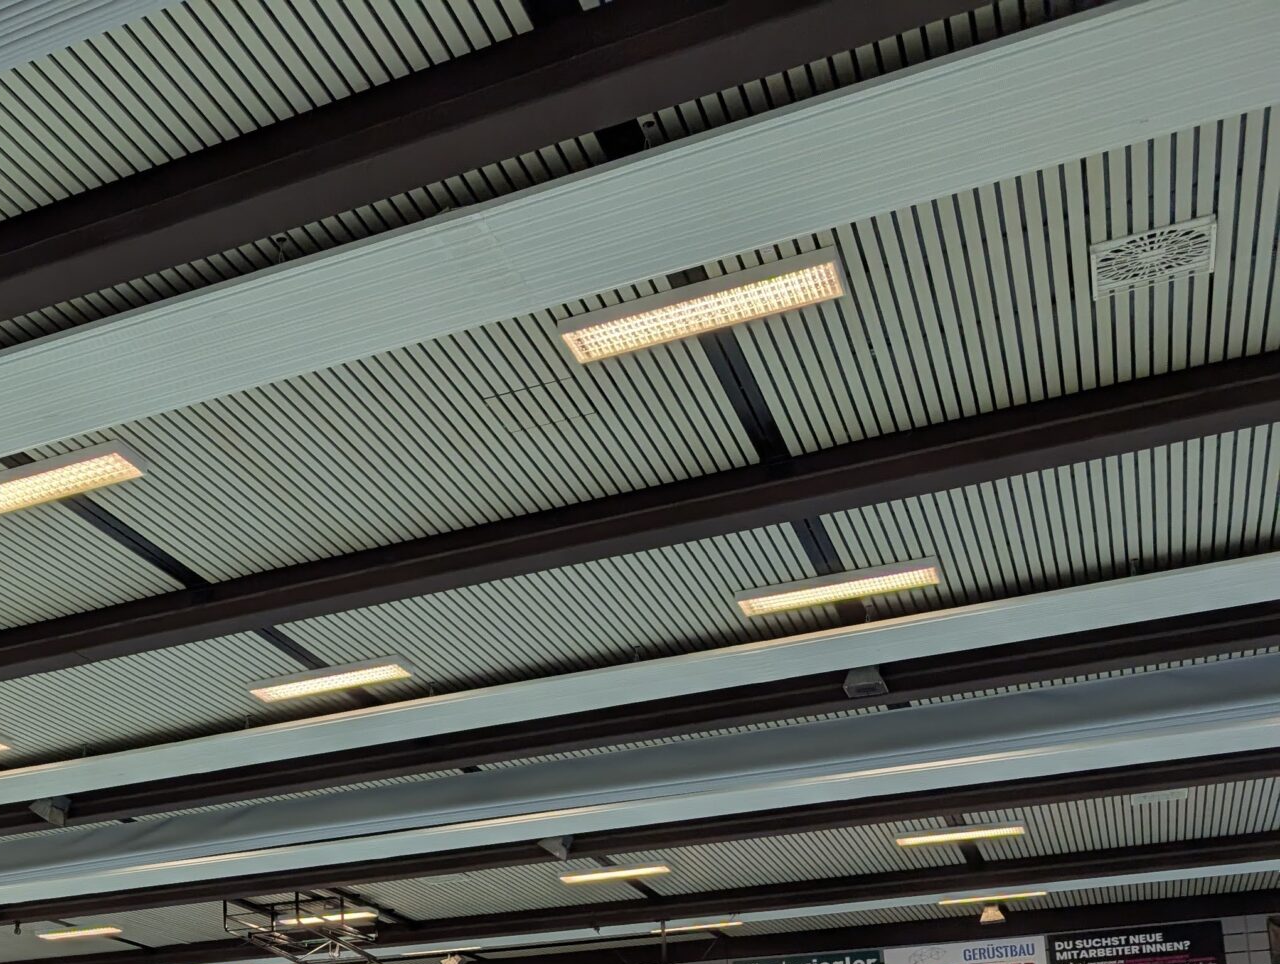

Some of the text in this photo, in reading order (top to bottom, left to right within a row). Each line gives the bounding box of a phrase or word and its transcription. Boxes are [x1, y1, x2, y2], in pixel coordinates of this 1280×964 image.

[1054, 933, 1164, 950] DU SUCHST NEUE
[963, 943, 1036, 962] GERÜSTBAU
